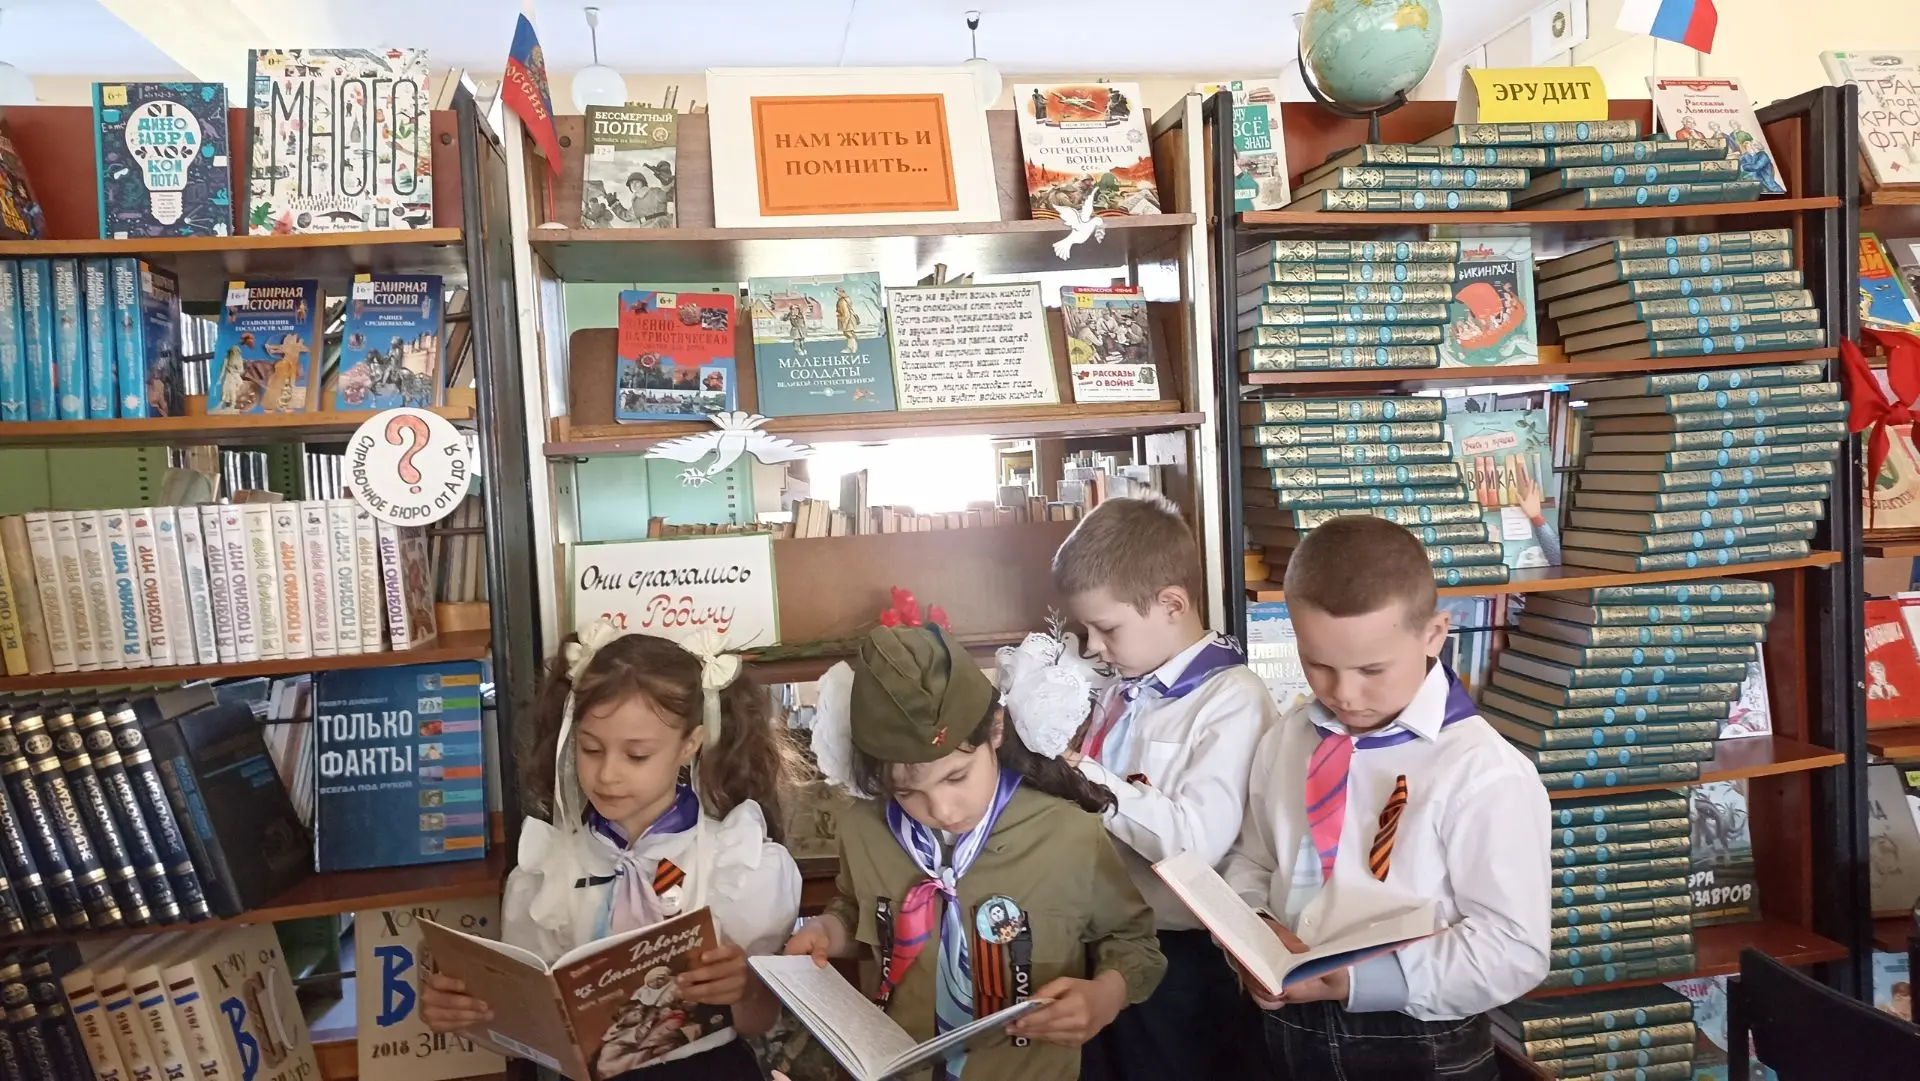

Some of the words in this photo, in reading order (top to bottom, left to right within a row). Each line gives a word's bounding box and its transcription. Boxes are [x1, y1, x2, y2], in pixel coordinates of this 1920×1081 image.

[1493, 82, 1591, 104] ЭРУДИТ
[148, 104, 176, 117] ОТ
[595, 112, 673, 122] БЕССМЕРТНЫЙ
[138, 118, 186, 130] ДИНО
[594, 120, 648, 136] ПОЛК
[1233, 116, 1265, 137] ВСЁ
[138, 132, 196, 145] ЗАВРА
[270, 78, 418, 196] МНОГО
[776, 134, 830, 148] НАМ
[838, 131, 910, 147] ЖИТЬ
[916, 130, 932, 144] И
[1060, 135, 1110, 144] ВЕЛИКАЯ
[1244, 136, 1270, 150] ЗНАТЬ
[1040, 145, 1134, 154] ОТЕЧЕСТВЕННАЯ
[786, 158, 928, 176] ПОМНИТЬ...
[1066, 155, 1112, 164] ВОЙНА
[151, 174, 180, 187] ПОТА
[116, 266, 126, 310] ВСЕМИРНАЯ
[124, 270, 134, 305] ИСТОРИЯ
[894, 292, 922, 302] Пусть
[894, 304, 921, 314] Пусть
[625, 331, 728, 344] ПАТРИОТИЧЕСКАЯ
[778, 354, 870, 368] МАЛЕНЬКИЕ
[777, 380, 810, 388] ВЕЛИКОЙ
[814, 376, 876, 386] ОТЕЧЕСТВЕННОЙ
[790, 366, 860, 380] СОЛДАТЫ
[906, 395, 933, 405] Пусть
[444, 443, 461, 456] Я
[352, 436, 388, 512] СПРАВОЧНОЕ
[451, 460, 466, 480] ДО
[444, 481, 461, 495] А
[434, 492, 452, 508] ОТ
[390, 504, 431, 519] БЮРО
[280, 540, 296, 572] МИР
[336, 530, 351, 564] МИР
[382, 536, 396, 566] МИР
[110, 541, 129, 574] МИР
[138, 545, 155, 575] МИР
[208, 544, 225, 574] МИР
[228, 542, 244, 572] МИР
[580, 565, 622, 591] Они
[628, 566, 751, 596] сражались
[211, 576, 231, 636] ПОЗНАЮ
[232, 574, 251, 632] ПОЗНАЮ
[284, 574, 301, 632] ПОЗНАЮ
[339, 566, 356, 628] ПОЗНАЮ
[385, 568, 404, 626] ПОЗНАЮ
[116, 578, 138, 641] ПОЗНАЮ
[144, 578, 165, 636] ПОЗНАЮ
[642, 594, 736, 633] Родину
[239, 634, 253, 644] Я
[288, 632, 300, 644] Я
[340, 629, 357, 641] Я
[390, 627, 405, 637] Я
[124, 642, 140, 656] Я
[152, 637, 165, 647] Я
[218, 636, 234, 647] Я
[318, 710, 413, 744] ТОЛЬКО
[320, 746, 413, 778] ФАКТЫ
[320, 785, 356, 795] ВСЕГДА
[358, 783, 378, 792] ПОД
[380, 780, 413, 790] РУКОЙ
[52, 777, 94, 862] ЭНЦИКЛОПЕДИЯ
[1688, 870, 1714, 888] ЭРА
[629, 924, 701, 962] Девочка
[598, 937, 704, 988] Сталинграда
